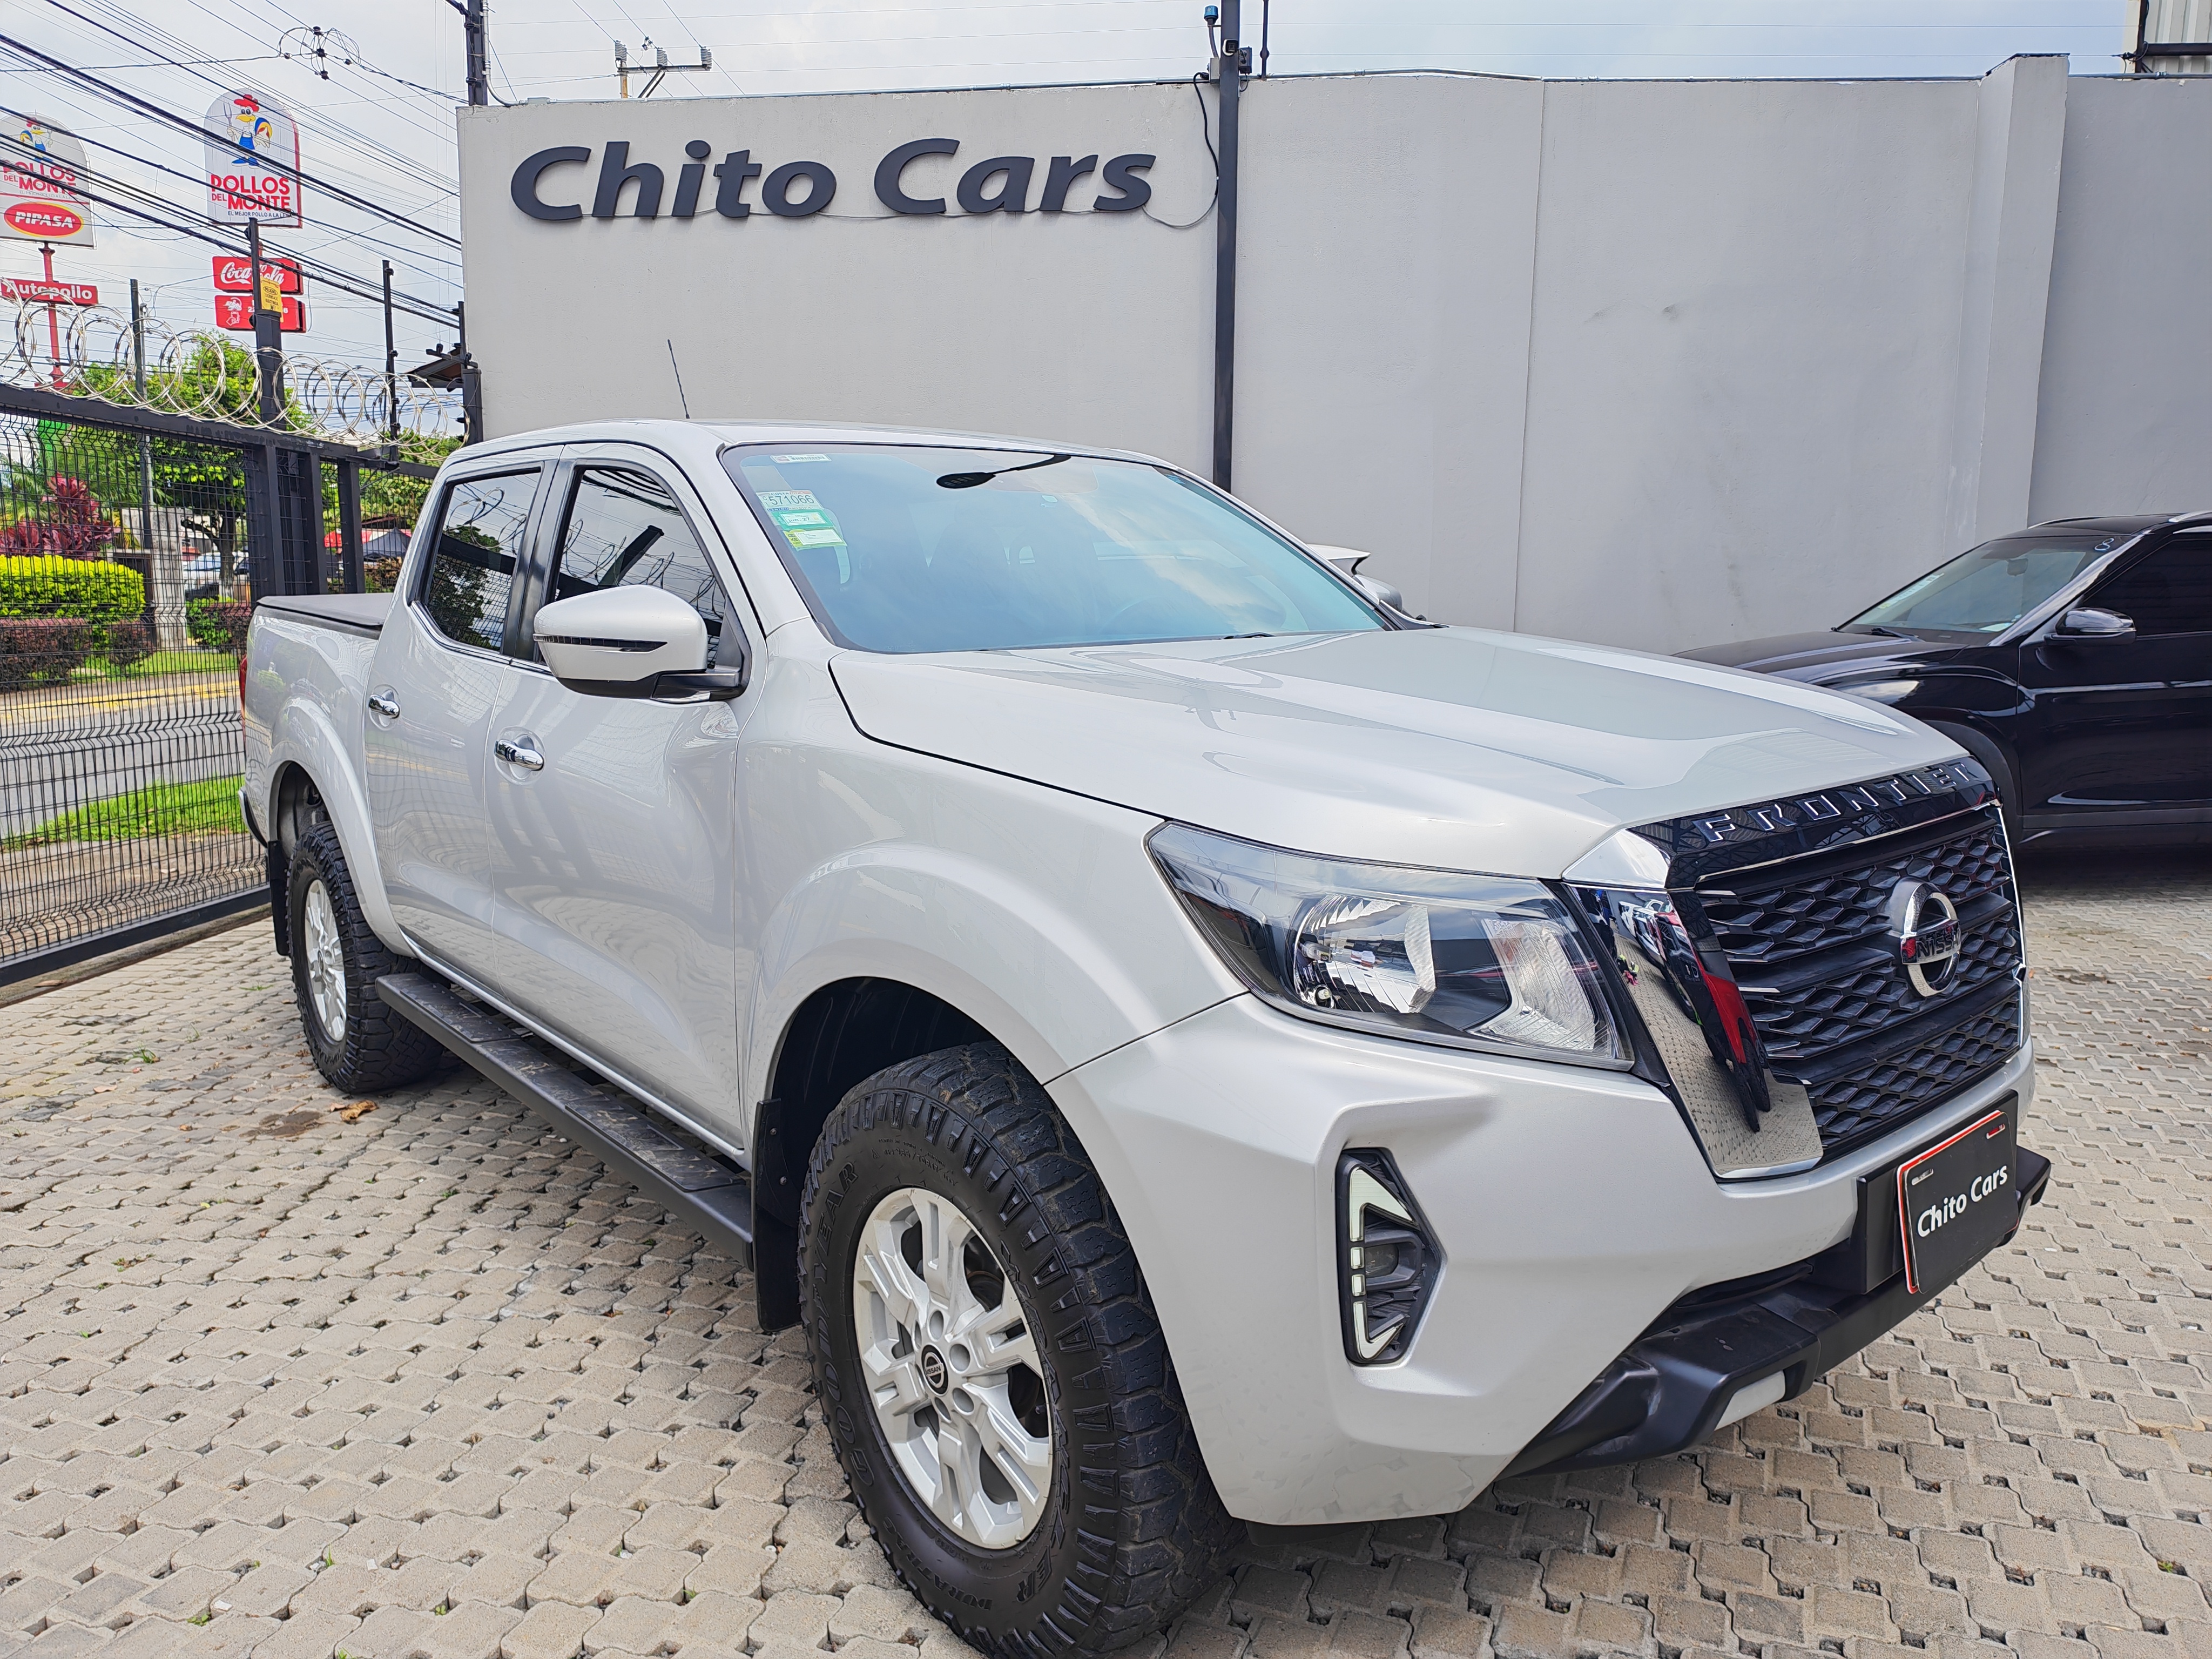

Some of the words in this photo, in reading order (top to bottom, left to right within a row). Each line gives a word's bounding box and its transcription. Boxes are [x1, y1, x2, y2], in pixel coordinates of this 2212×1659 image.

[211, 174, 290, 195] POLLOS
[510, 140, 837, 221] Chito
[874, 138, 1156, 215] Cars
[212, 193, 227, 201] DEL
[228, 194, 291, 212] MONTE
[15, 211, 73, 228] PIPASA
[6, 280, 92, 300] Autopollo
[768, 495, 814, 505] 571066
[2094, 537, 2114, 551] 8
[1692, 763, 1977, 842] FRONTIER
[1917, 1190, 1967, 1237] Chito
[1971, 1165, 2008, 1203] Cars
[813, 1161, 875, 1486] GOODYEAR
[882, 1516, 993, 1611] DURATRAC
